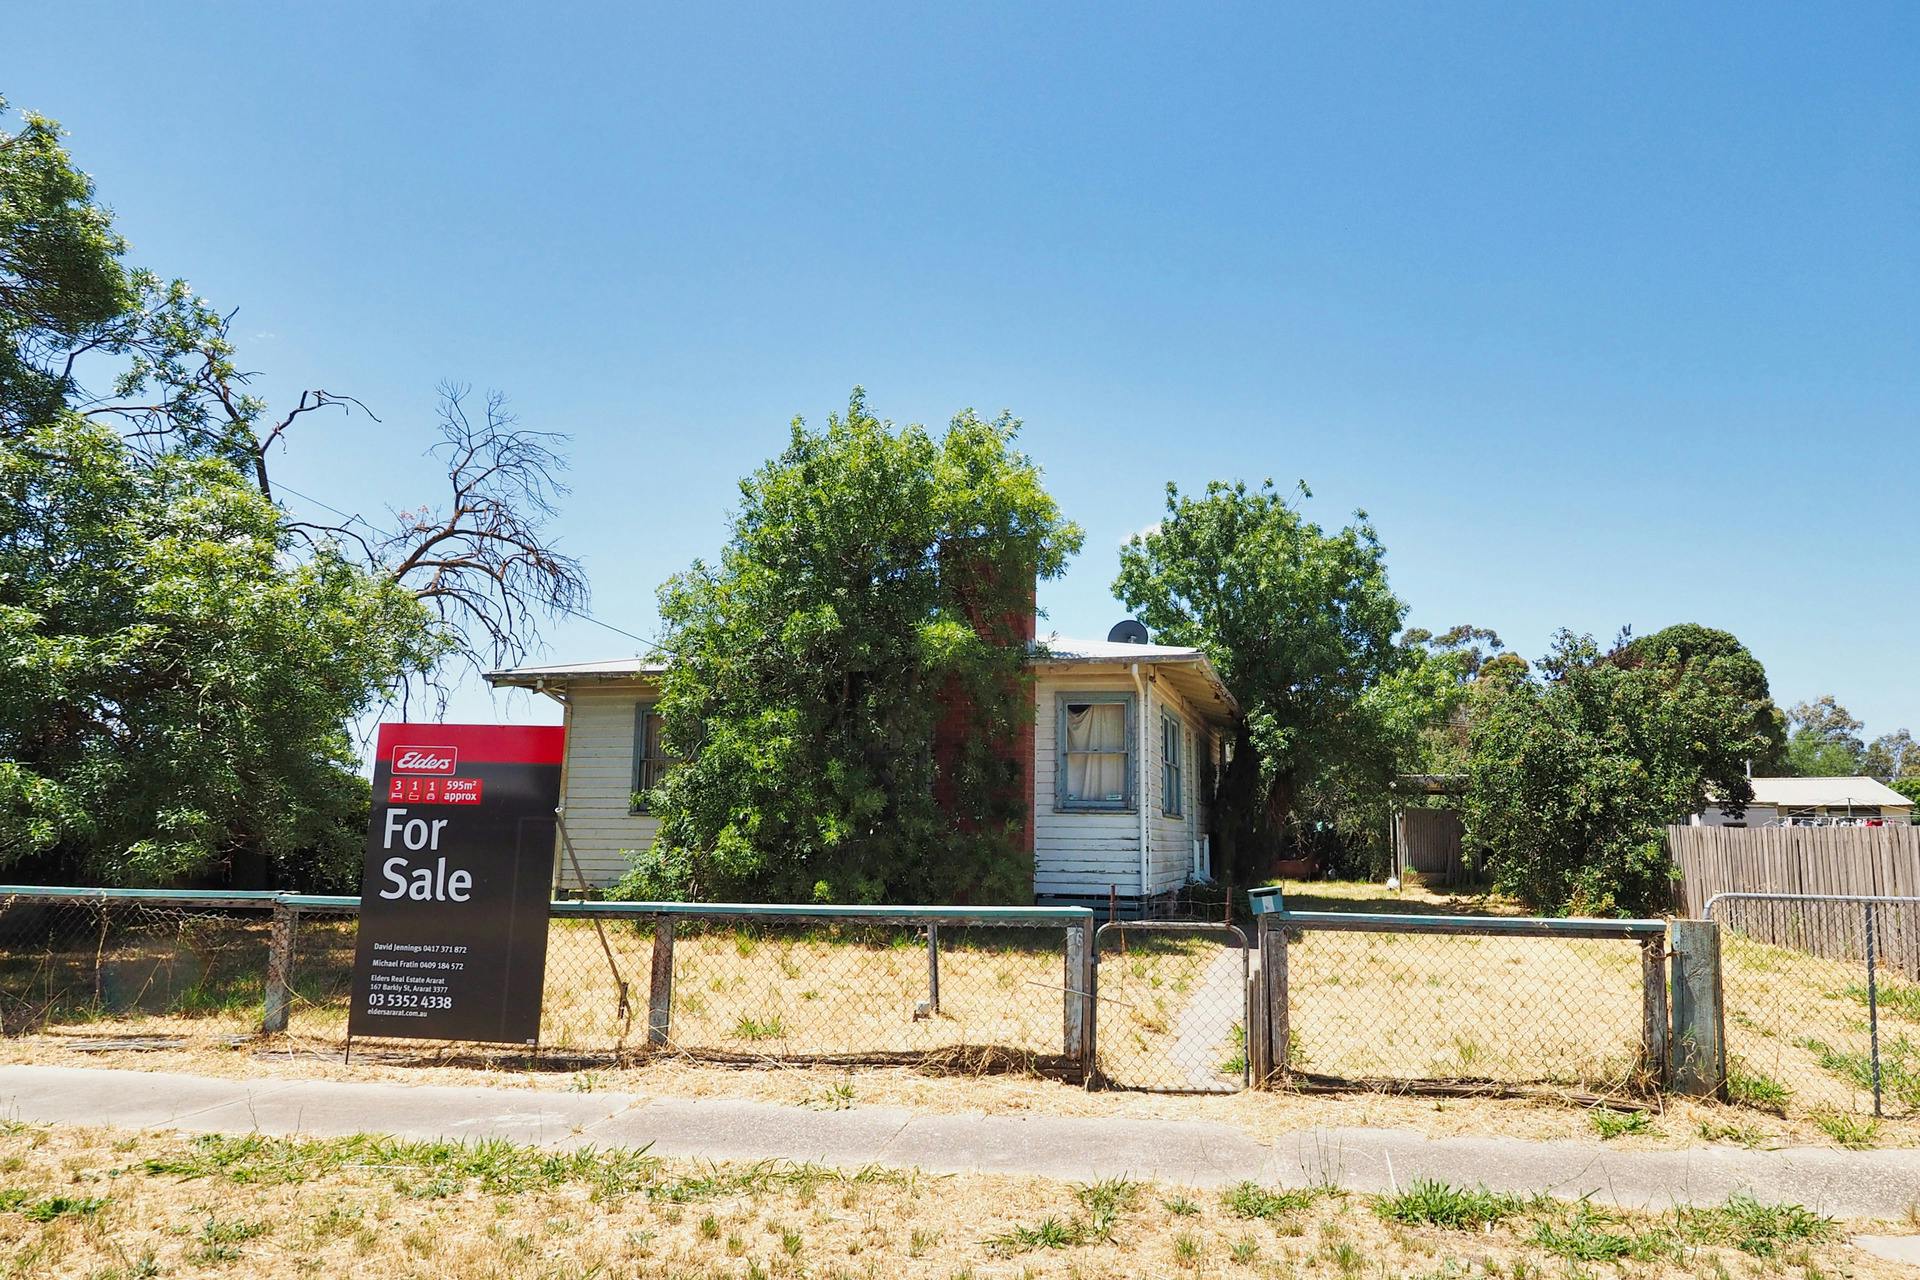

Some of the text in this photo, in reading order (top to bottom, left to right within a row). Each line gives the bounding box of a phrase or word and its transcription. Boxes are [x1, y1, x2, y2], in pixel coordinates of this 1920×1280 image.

[397, 751, 451, 770] Elders
[395, 780, 477, 791] 3 1 1 595m²
[444, 792, 477, 801] approx
[383, 808, 448, 850] For
[379, 857, 473, 902] Sale
[393, 944, 422, 953] Jennings
[423, 945, 440, 953] 0417
[440, 945, 453, 953] 371
[454, 946, 467, 954] 872
[372, 959, 398, 967] Michael
[399, 960, 418, 968] Fratin
[419, 961, 436, 969] 0409
[451, 962, 464, 970] 572
[391, 975, 405, 983] Real
[382, 984, 402, 992] Barkly
[412, 985, 432, 993] Ararat
[368, 993, 452, 1009] 03 5352 4338
[367, 1008, 428, 1017] eldersararat.com.au
